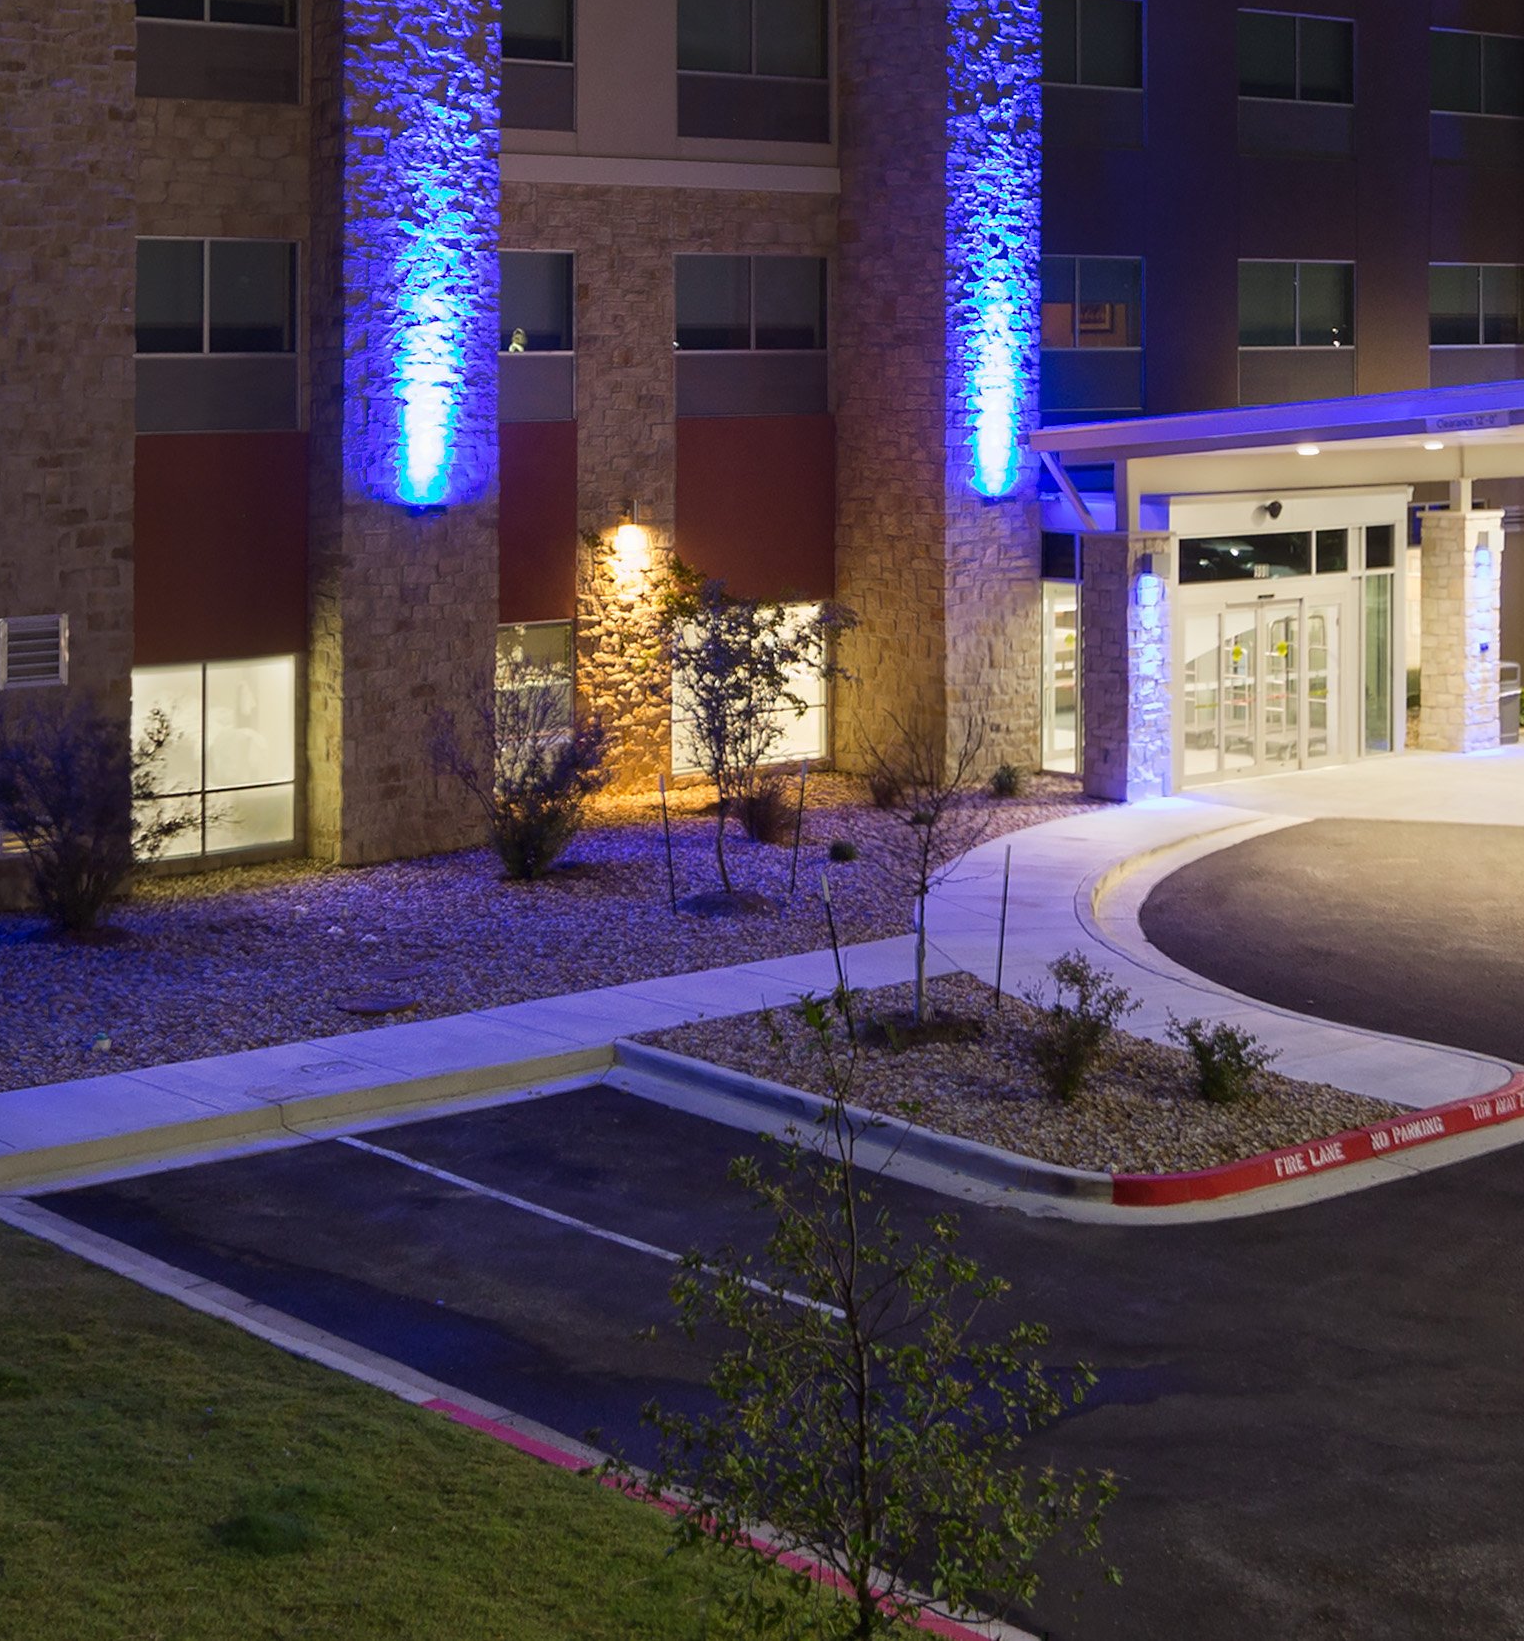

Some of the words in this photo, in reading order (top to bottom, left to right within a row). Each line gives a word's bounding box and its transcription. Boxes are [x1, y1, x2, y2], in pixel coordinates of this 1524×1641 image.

[1274, 1152, 1308, 1178] FIRE
[1308, 1141, 1347, 1167] LANE
[1369, 1129, 1391, 1152] NO
[1391, 1115, 1446, 1145] PARKING
